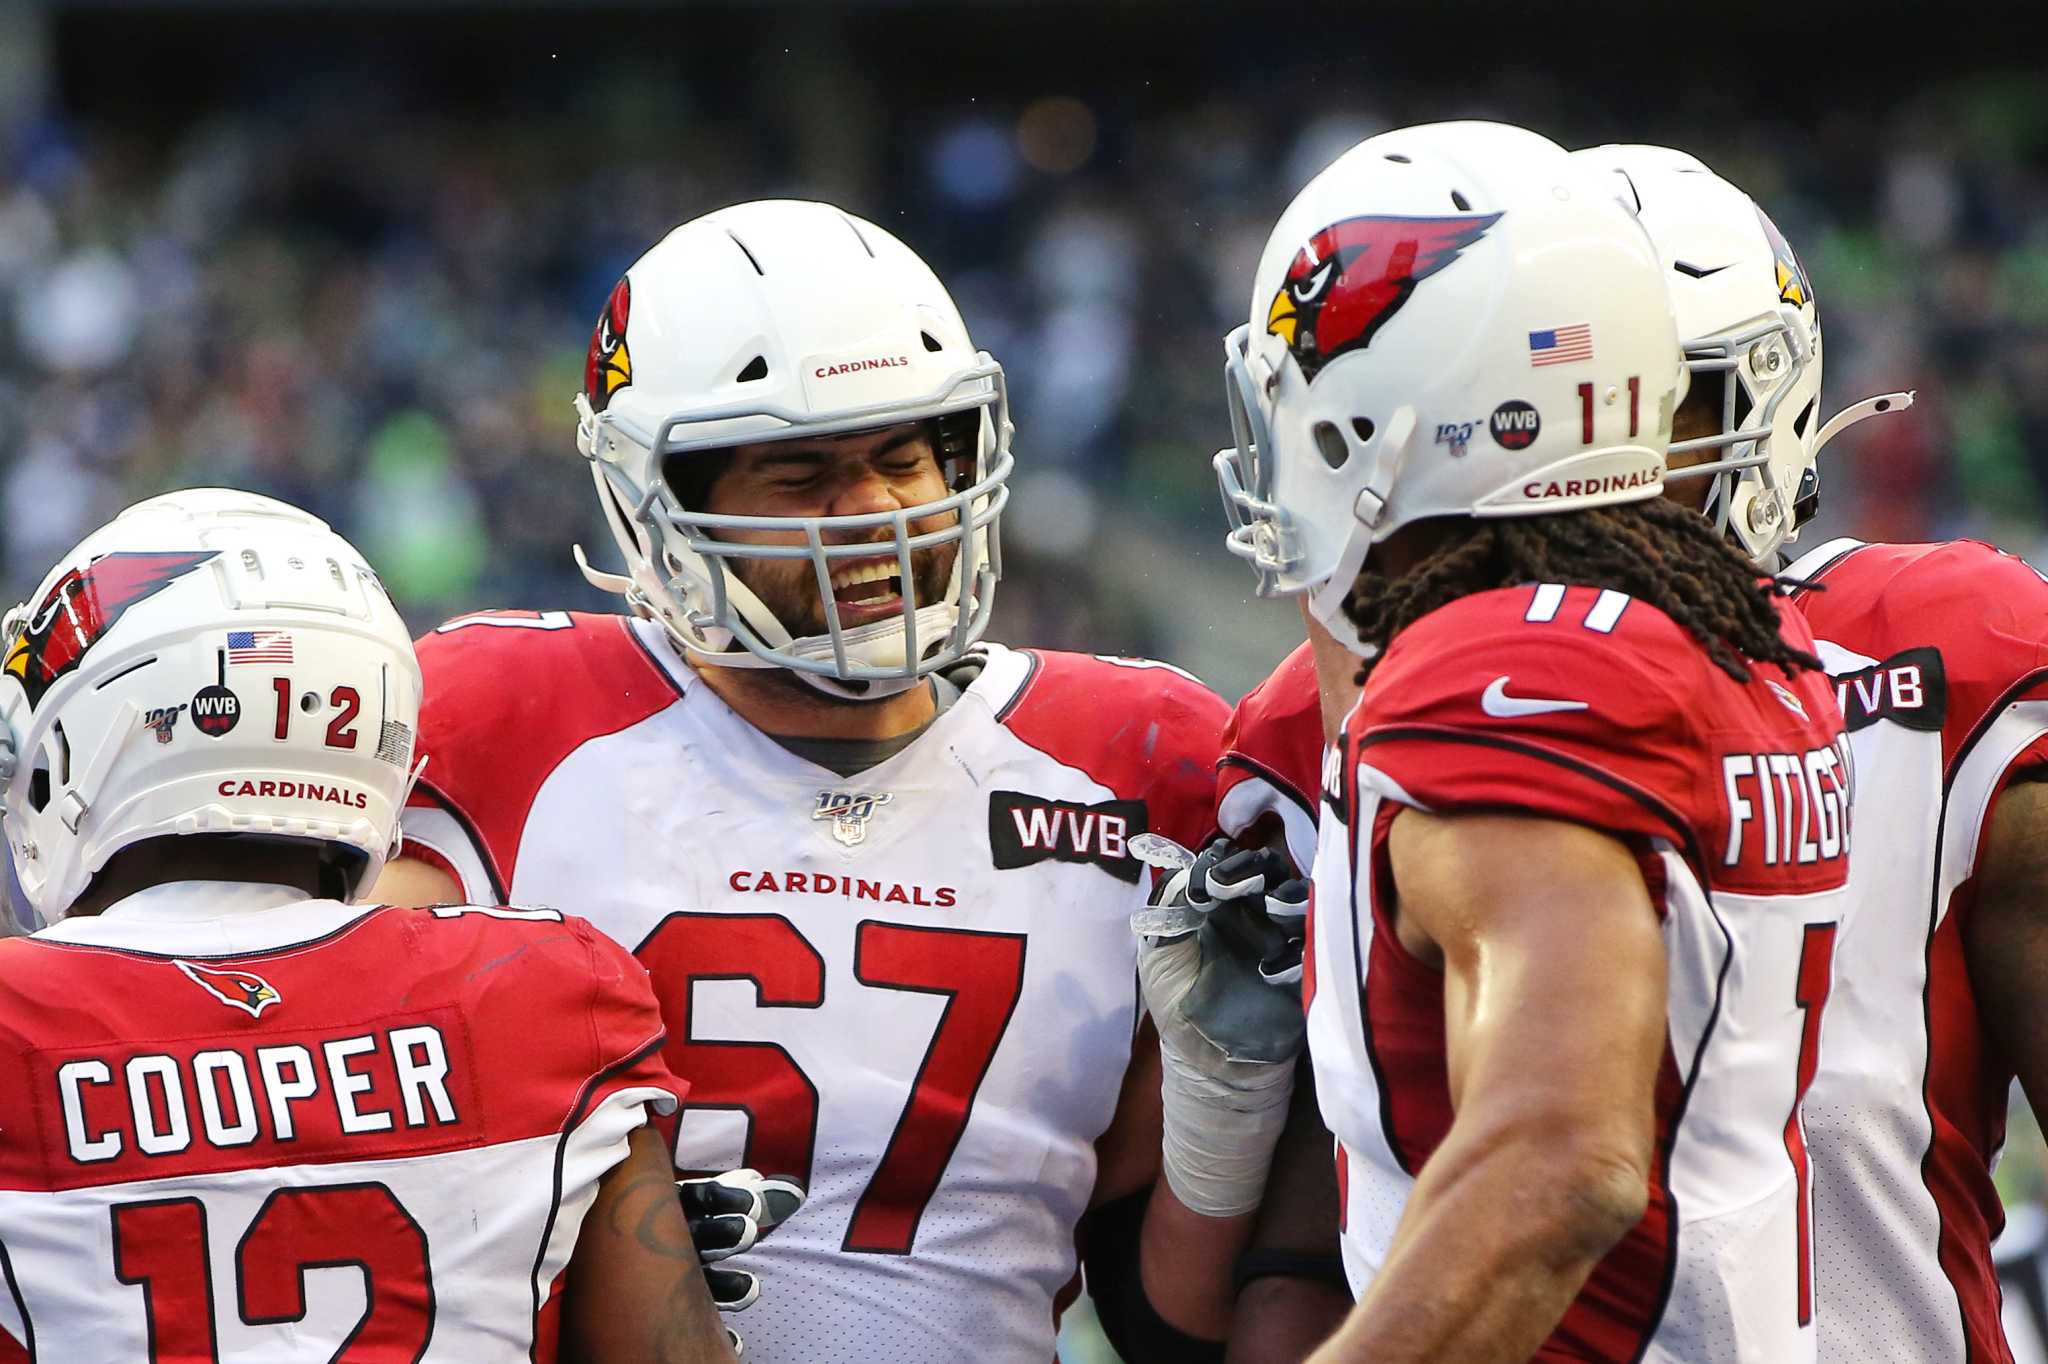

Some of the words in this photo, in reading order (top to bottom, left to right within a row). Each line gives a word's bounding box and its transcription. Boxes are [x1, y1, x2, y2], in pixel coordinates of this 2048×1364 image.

[815, 356, 908, 378] CARDINALS
[1494, 410, 1537, 431] WVB
[1577, 376, 1640, 445] 11
[1523, 466, 1660, 499] CARDINALS
[195, 696, 236, 716] WVB
[272, 677, 361, 750] 12
[1836, 664, 1925, 721] VB
[217, 780, 368, 809] CARDINALS
[1010, 805, 1128, 859] WVB
[729, 871, 957, 908] CARDINALS
[57, 1024, 462, 1165] COOPER
[633, 911, 1027, 1255] 67
[110, 1180, 437, 1364] 12
